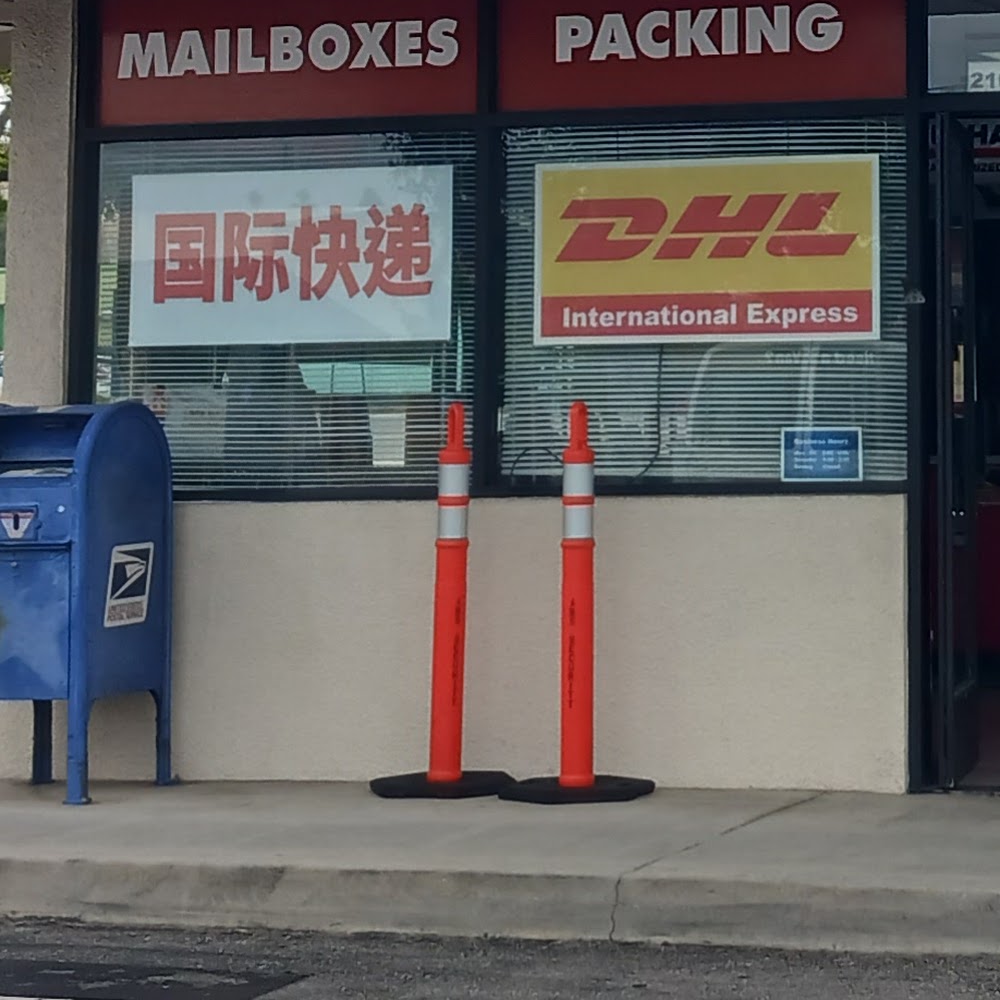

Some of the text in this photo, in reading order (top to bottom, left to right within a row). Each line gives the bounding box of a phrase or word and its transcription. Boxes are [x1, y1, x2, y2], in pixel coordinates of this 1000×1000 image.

[117, 17, 459, 79] MAILBOXES
[555, 2, 844, 63] PACKING
[153, 203, 433, 304] 国际快递
[554, 191, 859, 262] DHL
[562, 303, 859, 329] International Express
